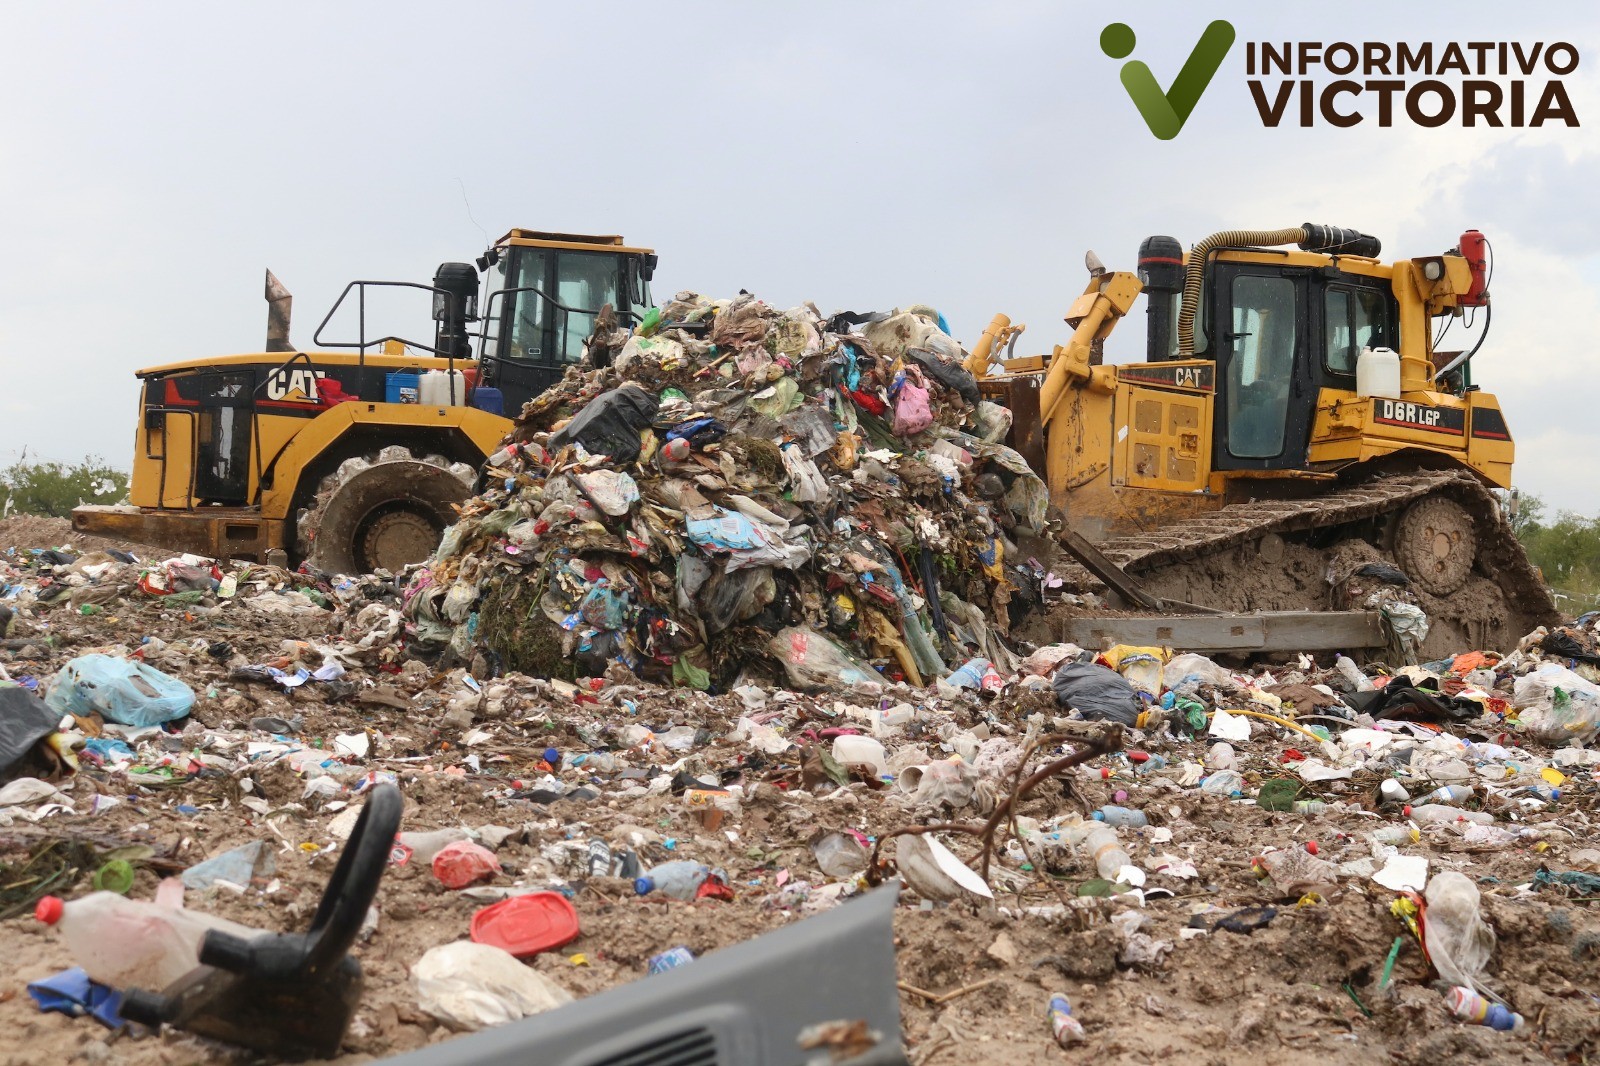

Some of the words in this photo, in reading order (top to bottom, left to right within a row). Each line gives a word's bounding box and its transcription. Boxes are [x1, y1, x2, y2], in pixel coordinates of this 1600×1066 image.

[267, 367, 326, 404] CAT
[1175, 367, 1202, 388] CAT
[1383, 400, 1416, 423] D6R
[1418, 408, 1440, 427] LGP
